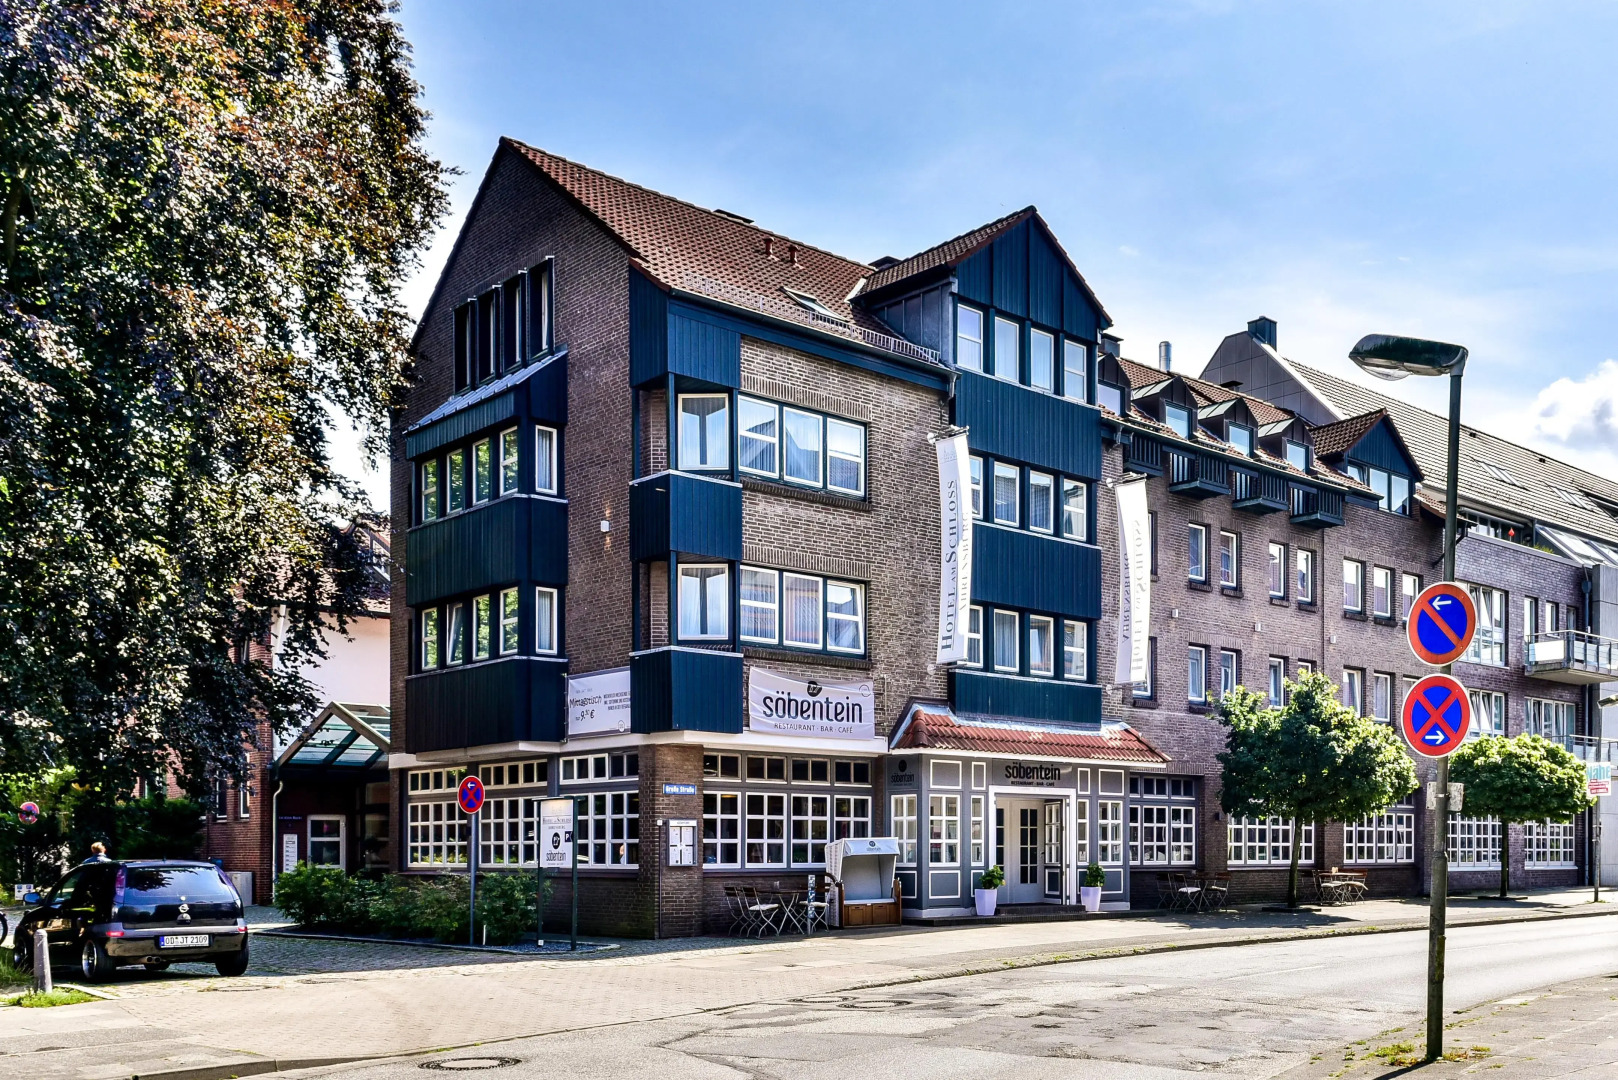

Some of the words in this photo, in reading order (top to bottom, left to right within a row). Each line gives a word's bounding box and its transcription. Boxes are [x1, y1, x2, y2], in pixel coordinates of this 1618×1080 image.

[946, 480, 957, 563] SCHLOSS
[941, 588, 955, 651] HOTEL
[569, 695, 602, 709] Mittagstisch
[763, 690, 863, 723] söbentein
[774, 722, 815, 732] RESTAURANT
[820, 724, 834, 733] BAR
[838, 726, 853, 734] CAFÉ
[1005, 761, 1061, 781] söbentein
[665, 785, 679, 793] Große
[680, 785, 695, 793] Straße
